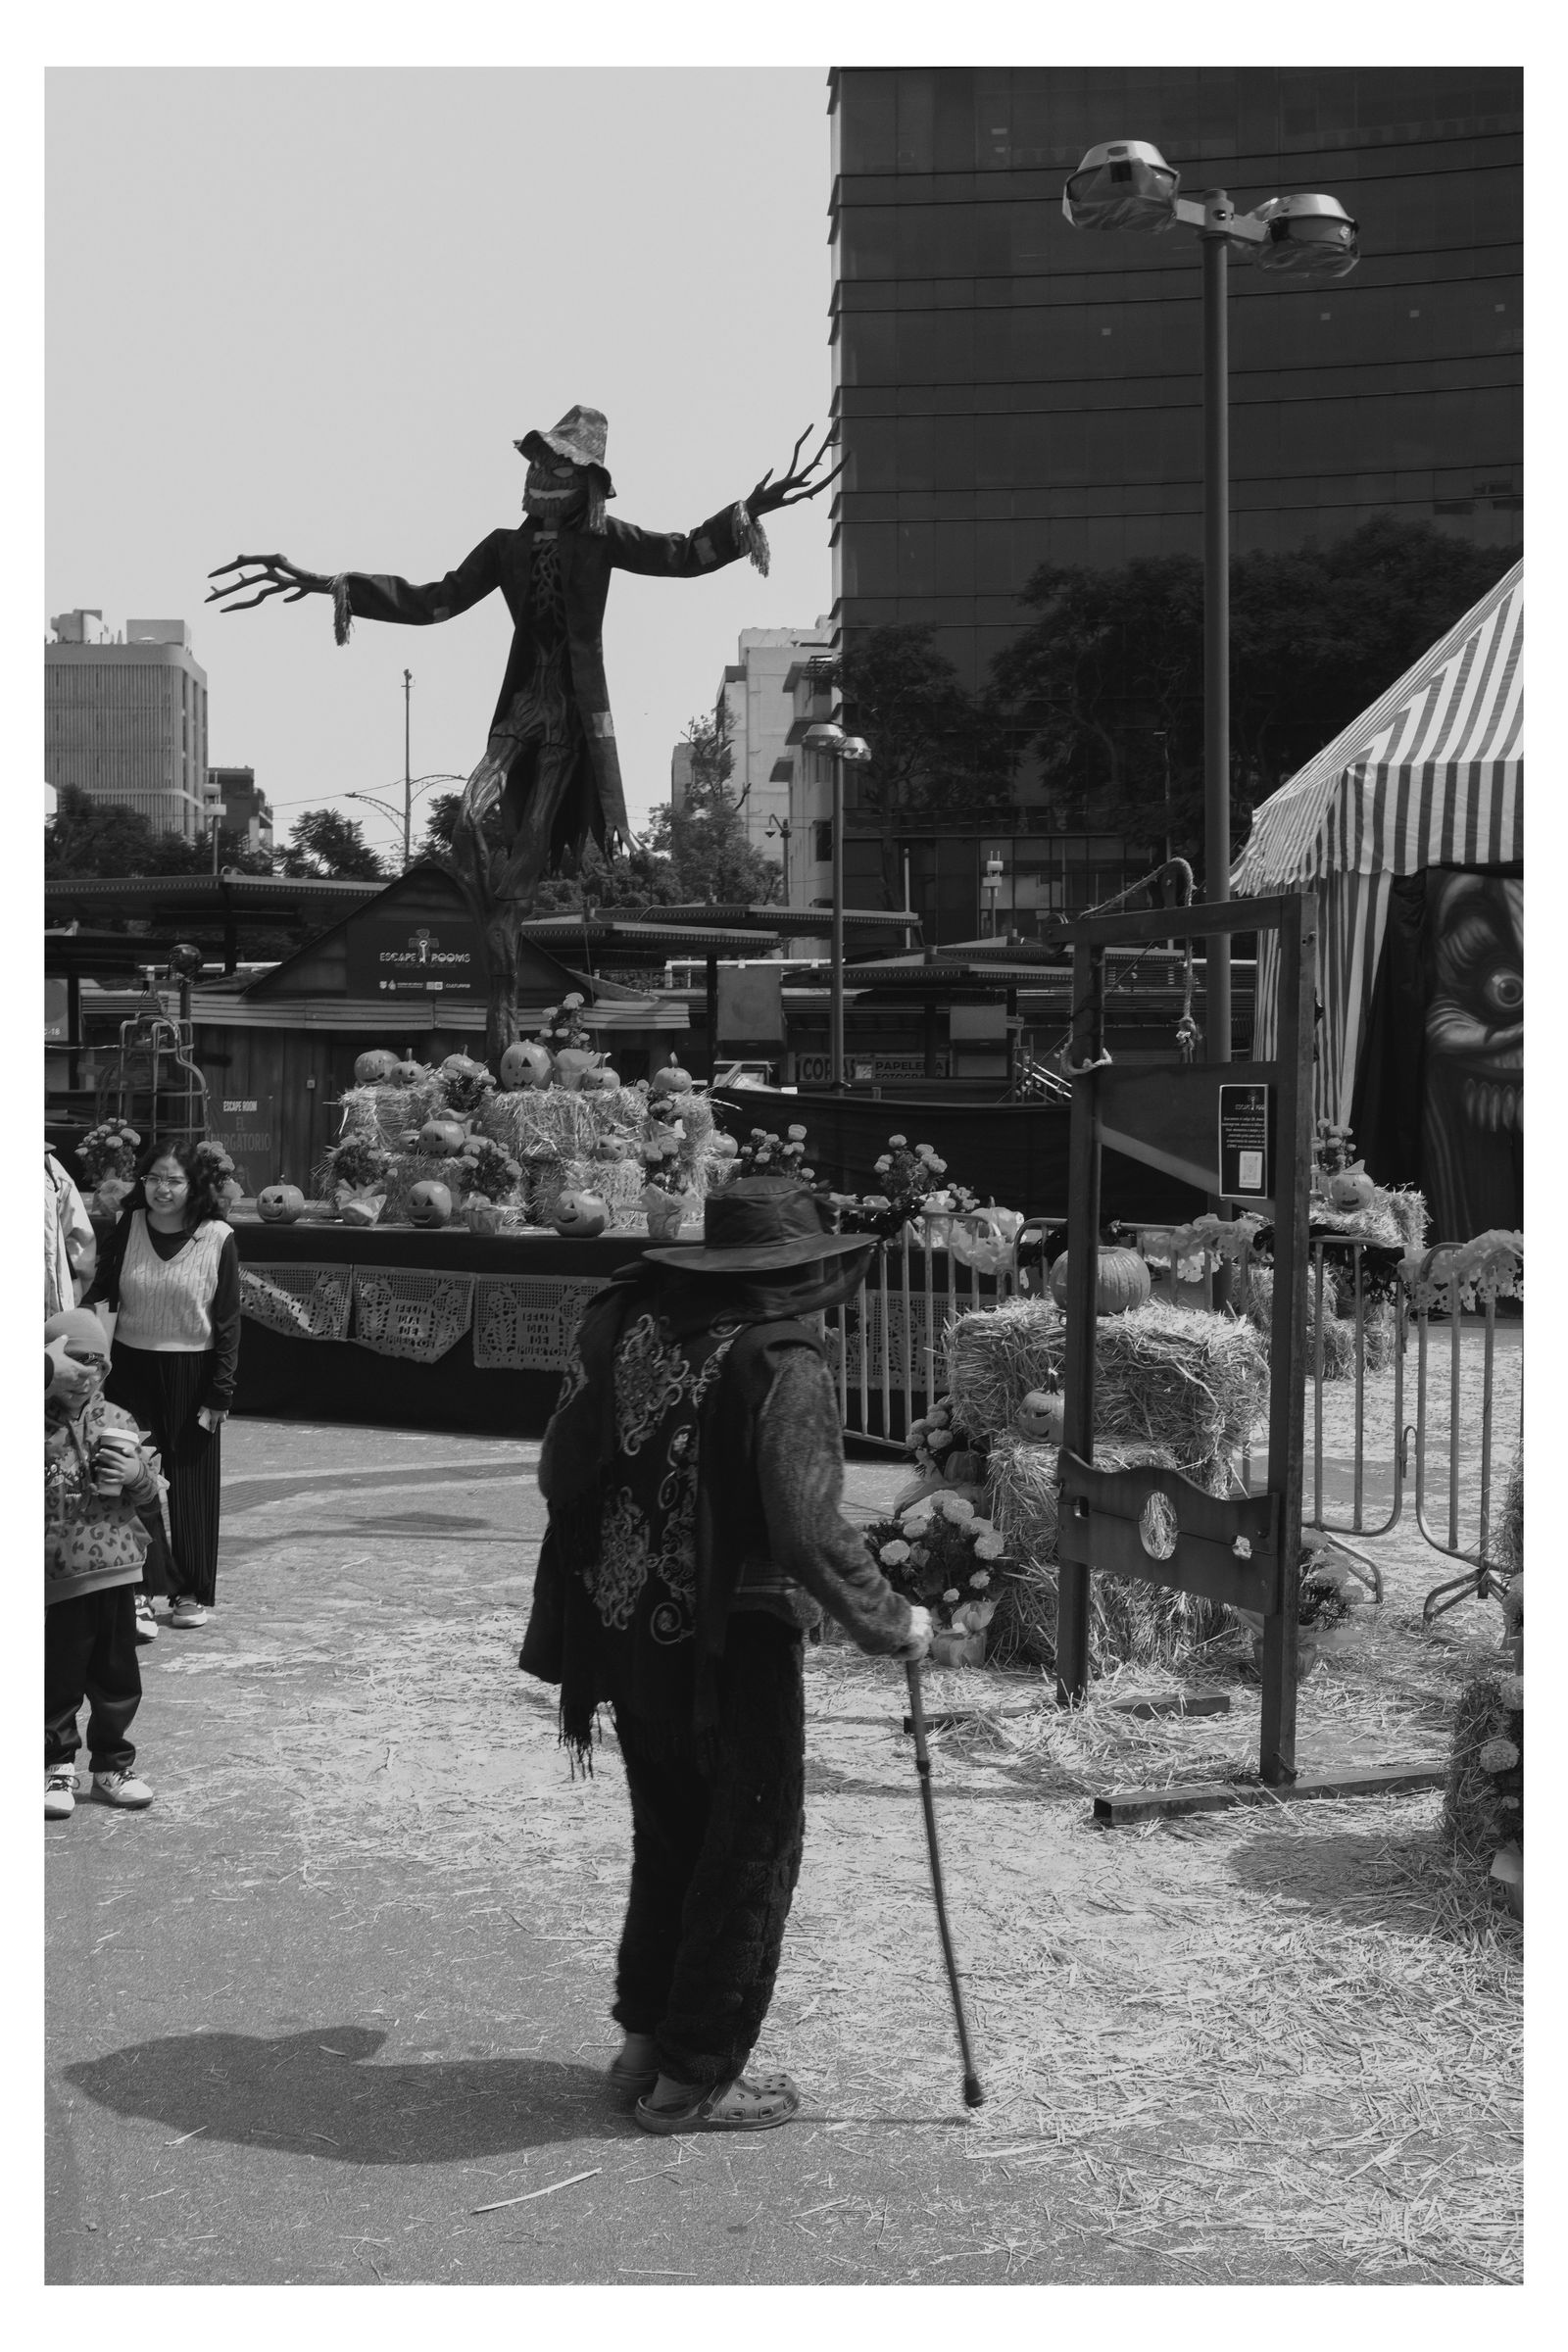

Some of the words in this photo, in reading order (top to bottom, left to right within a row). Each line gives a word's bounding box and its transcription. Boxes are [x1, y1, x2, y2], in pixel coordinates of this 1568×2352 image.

[379, 952, 416, 962] ESCAPE
[430, 953, 471, 963] ROOMS
[803, 1057, 856, 1080] COPS
[875, 1060, 943, 1070] PAPELEA
[222, 1100, 242, 1112] ESCAPE
[242, 1100, 258, 1112] ROOM
[235, 1116, 245, 1131] EL
[399, 1326, 418, 1336] DE
[529, 1335, 549, 1345] DE
